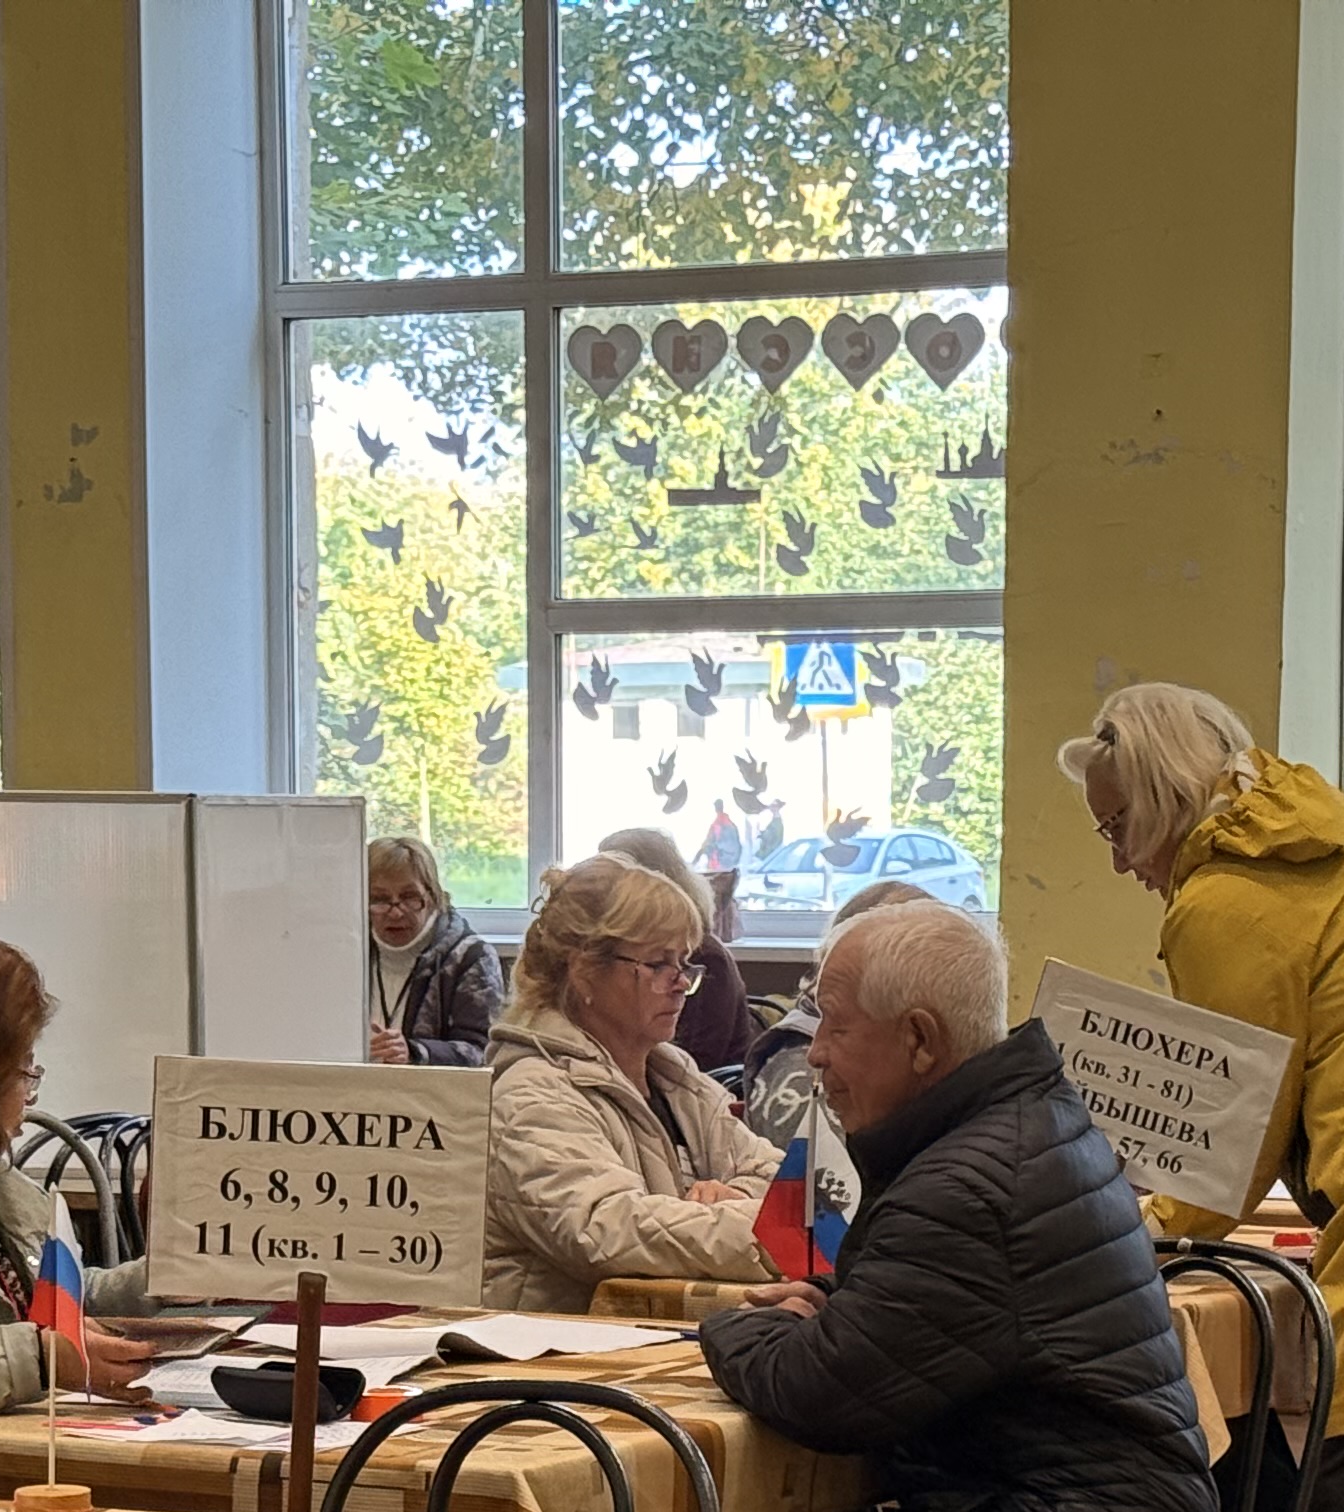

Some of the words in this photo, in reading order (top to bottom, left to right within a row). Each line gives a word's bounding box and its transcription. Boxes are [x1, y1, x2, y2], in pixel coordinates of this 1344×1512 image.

[1078, 1007, 1234, 1081] БЛЮХЕРА
[1072, 1049, 1112, 1080] (кв.
[1116, 1065, 1142, 1089] 31
[1160, 1078, 1195, 1110] 81)
[197, 1105, 446, 1151] БЛЮХЕРА
[1116, 1136, 1149, 1168] 57,
[1156, 1149, 1185, 1175] 66
[219, 1167, 254, 1209] 6,
[267, 1169, 301, 1211] 8,
[314, 1170, 350, 1212] 9,
[365, 1173, 421, 1216] 10,
[194, 1221, 234, 1256] 11
[250, 1224, 320, 1267] (кв.
[332, 1232, 346, 1262] 1
[387, 1231, 445, 1273] 30)
